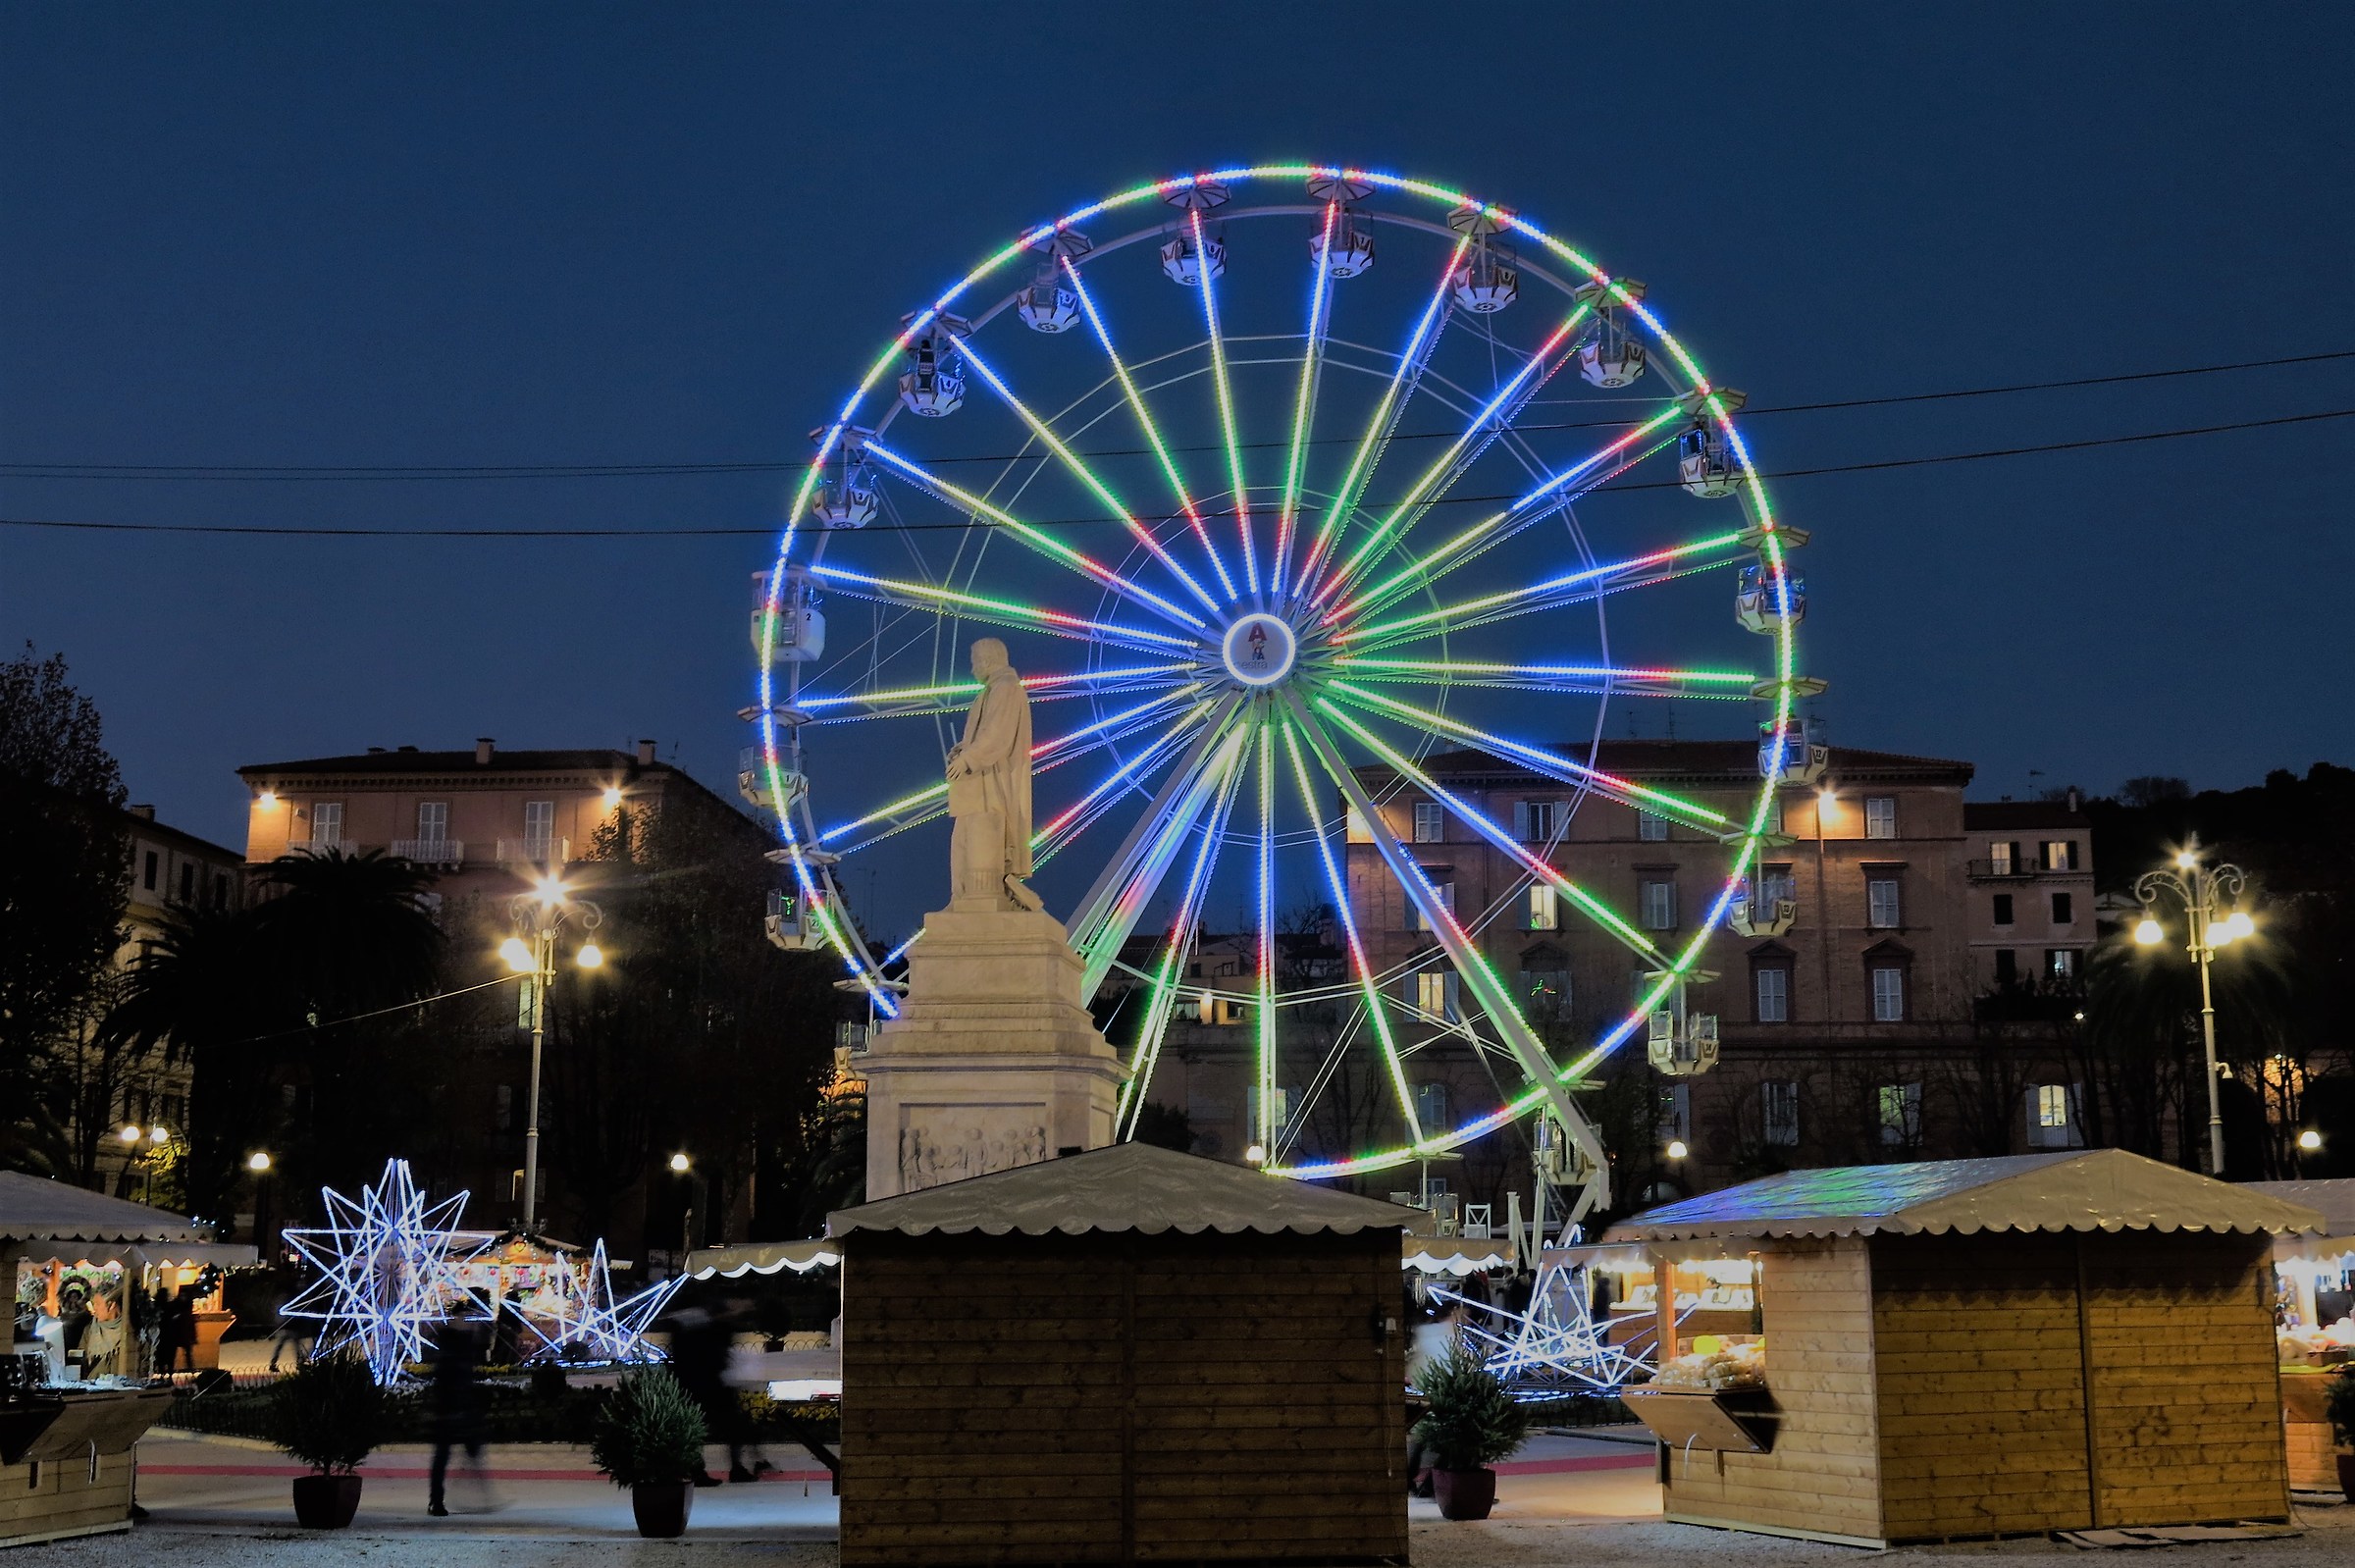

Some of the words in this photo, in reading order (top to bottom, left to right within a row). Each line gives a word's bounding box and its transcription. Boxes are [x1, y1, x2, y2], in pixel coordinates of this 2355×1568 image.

[858, 492, 864, 500] 3
[806, 612, 811, 621] 2
[1241, 660, 1268, 669] estra
